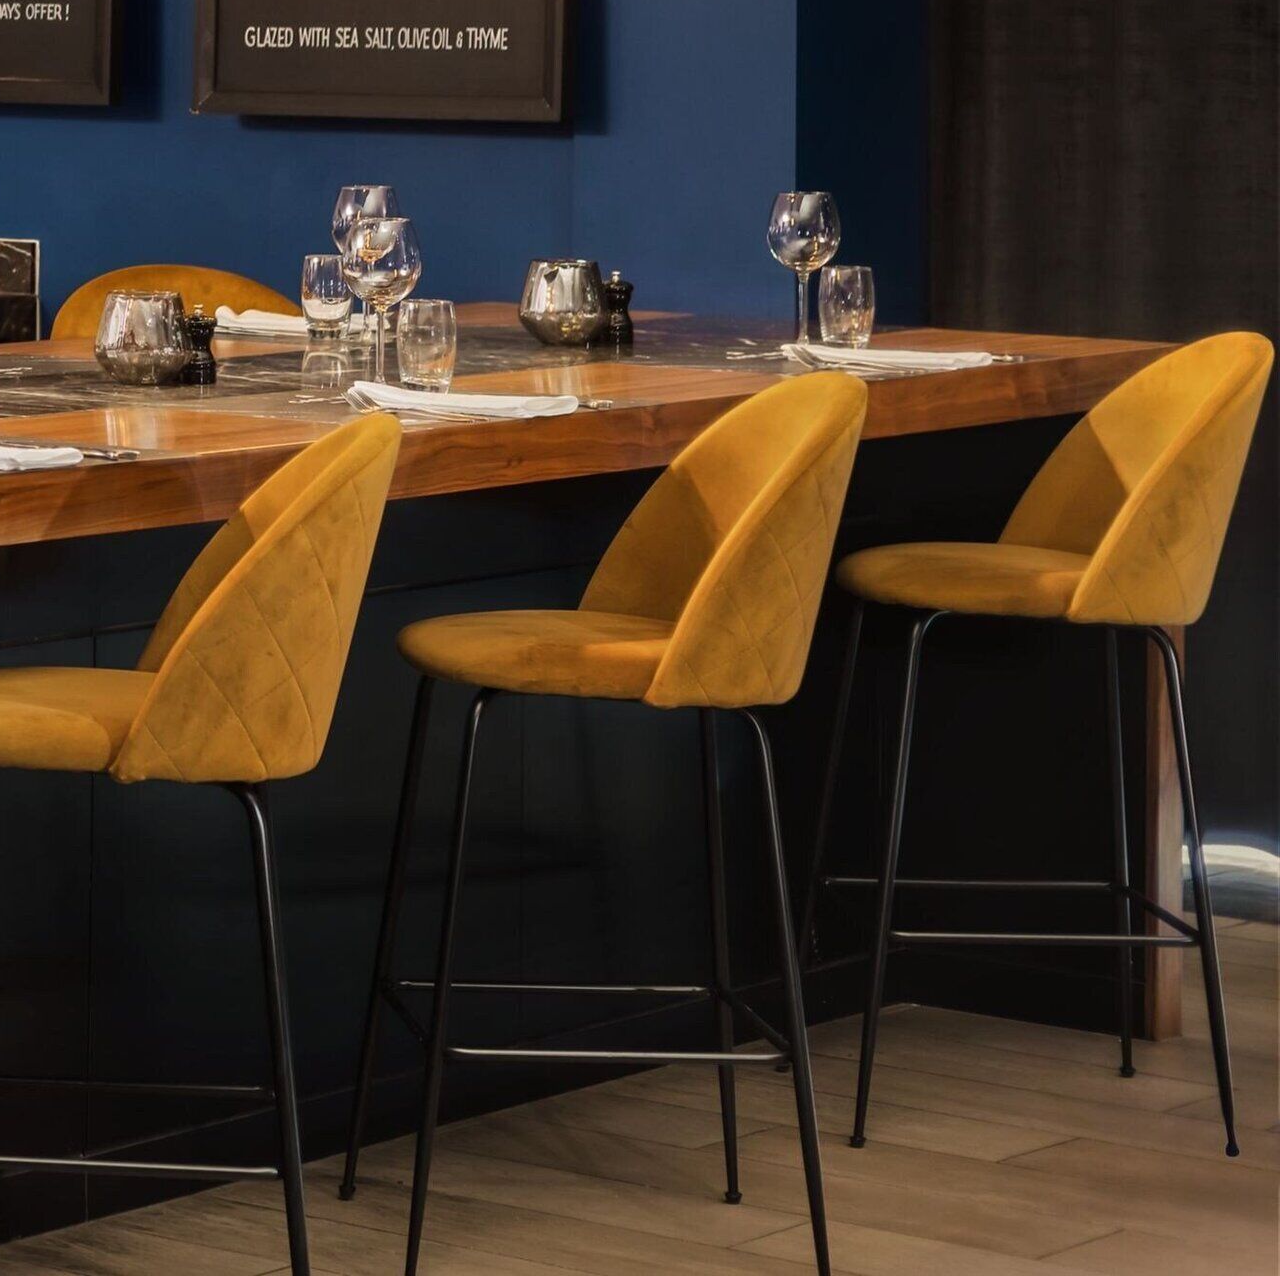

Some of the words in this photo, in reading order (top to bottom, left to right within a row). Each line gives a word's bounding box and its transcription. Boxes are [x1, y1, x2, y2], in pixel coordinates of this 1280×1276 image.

[244, 26, 294, 49] GLAZED
[298, 26, 330, 49] WITH
[335, 26, 359, 49] SEA
[364, 26, 395, 51] SALT,
[397, 27, 430, 50] OLIVE
[431, 27, 453, 50] OIL
[455, 30, 464, 49] &
[466, 27, 509, 50] THYME
